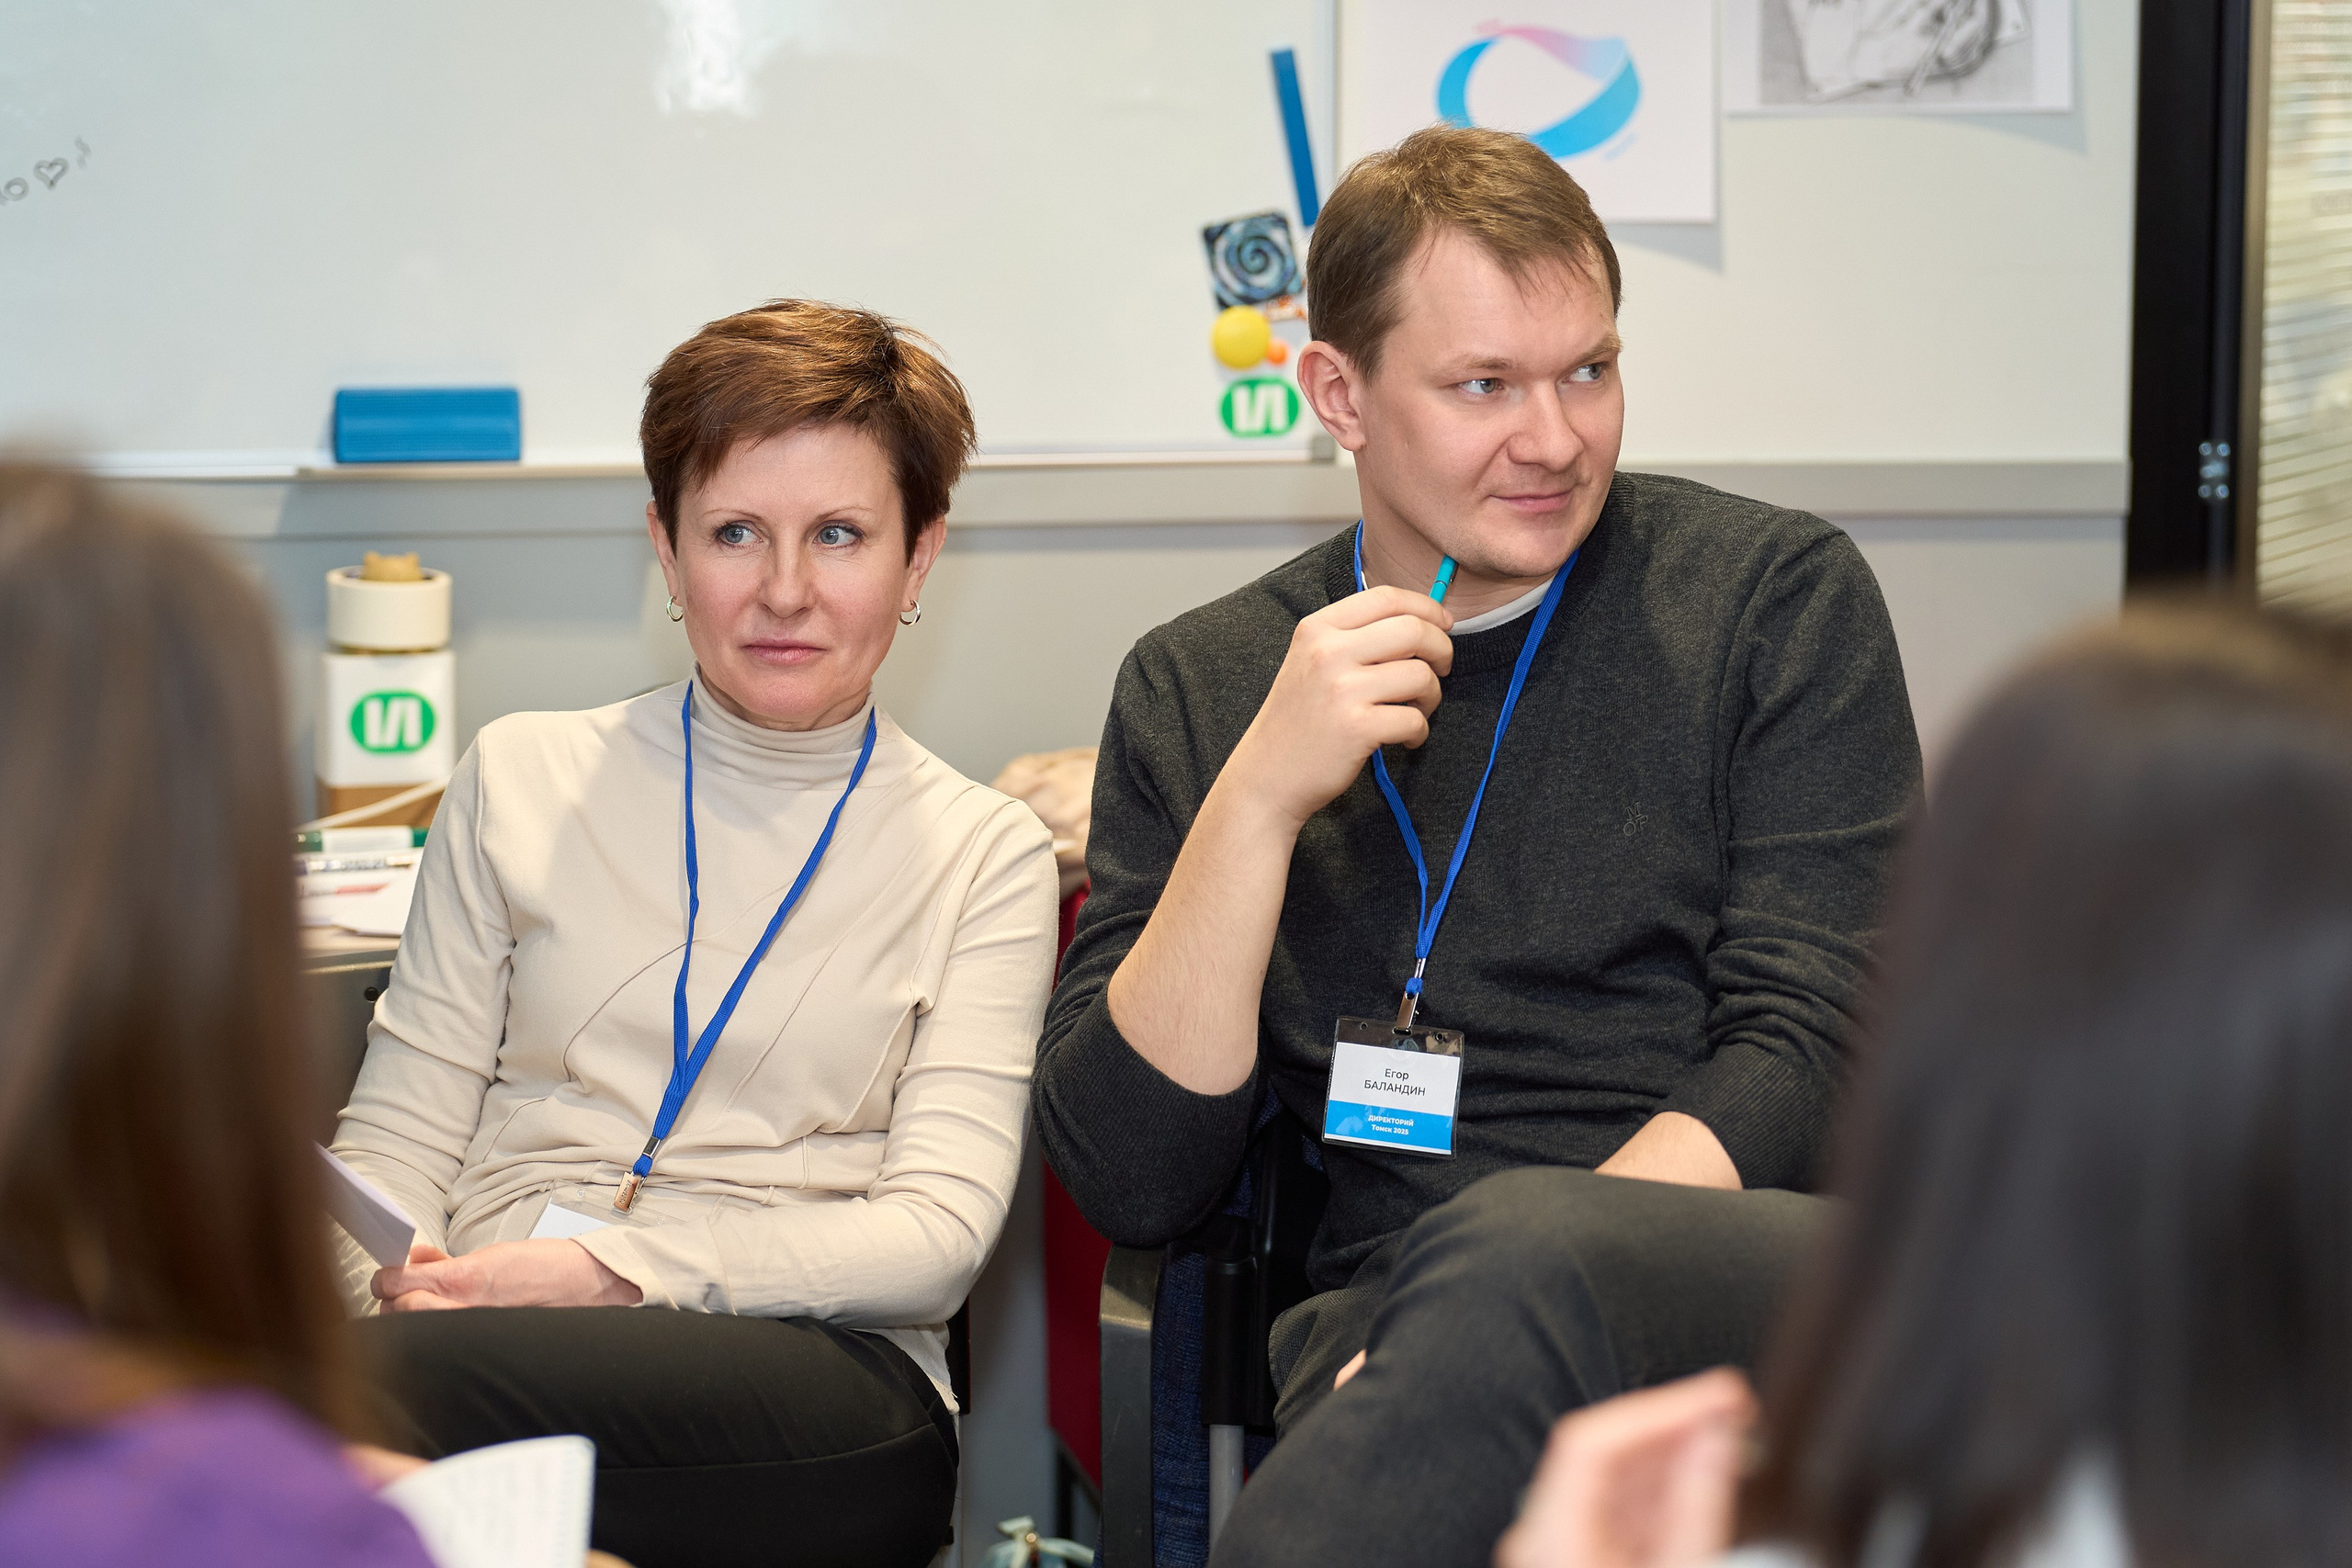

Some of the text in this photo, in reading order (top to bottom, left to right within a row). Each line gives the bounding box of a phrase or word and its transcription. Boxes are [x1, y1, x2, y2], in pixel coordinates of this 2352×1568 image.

[1385, 1068, 1409, 1080] Егор
[1364, 1080, 1426, 1096] БАЛАНДИН
[1368, 1114, 1414, 1127] ДИРЕКТОРИЙ
[1372, 1124, 1409, 1135] Томск 2025
